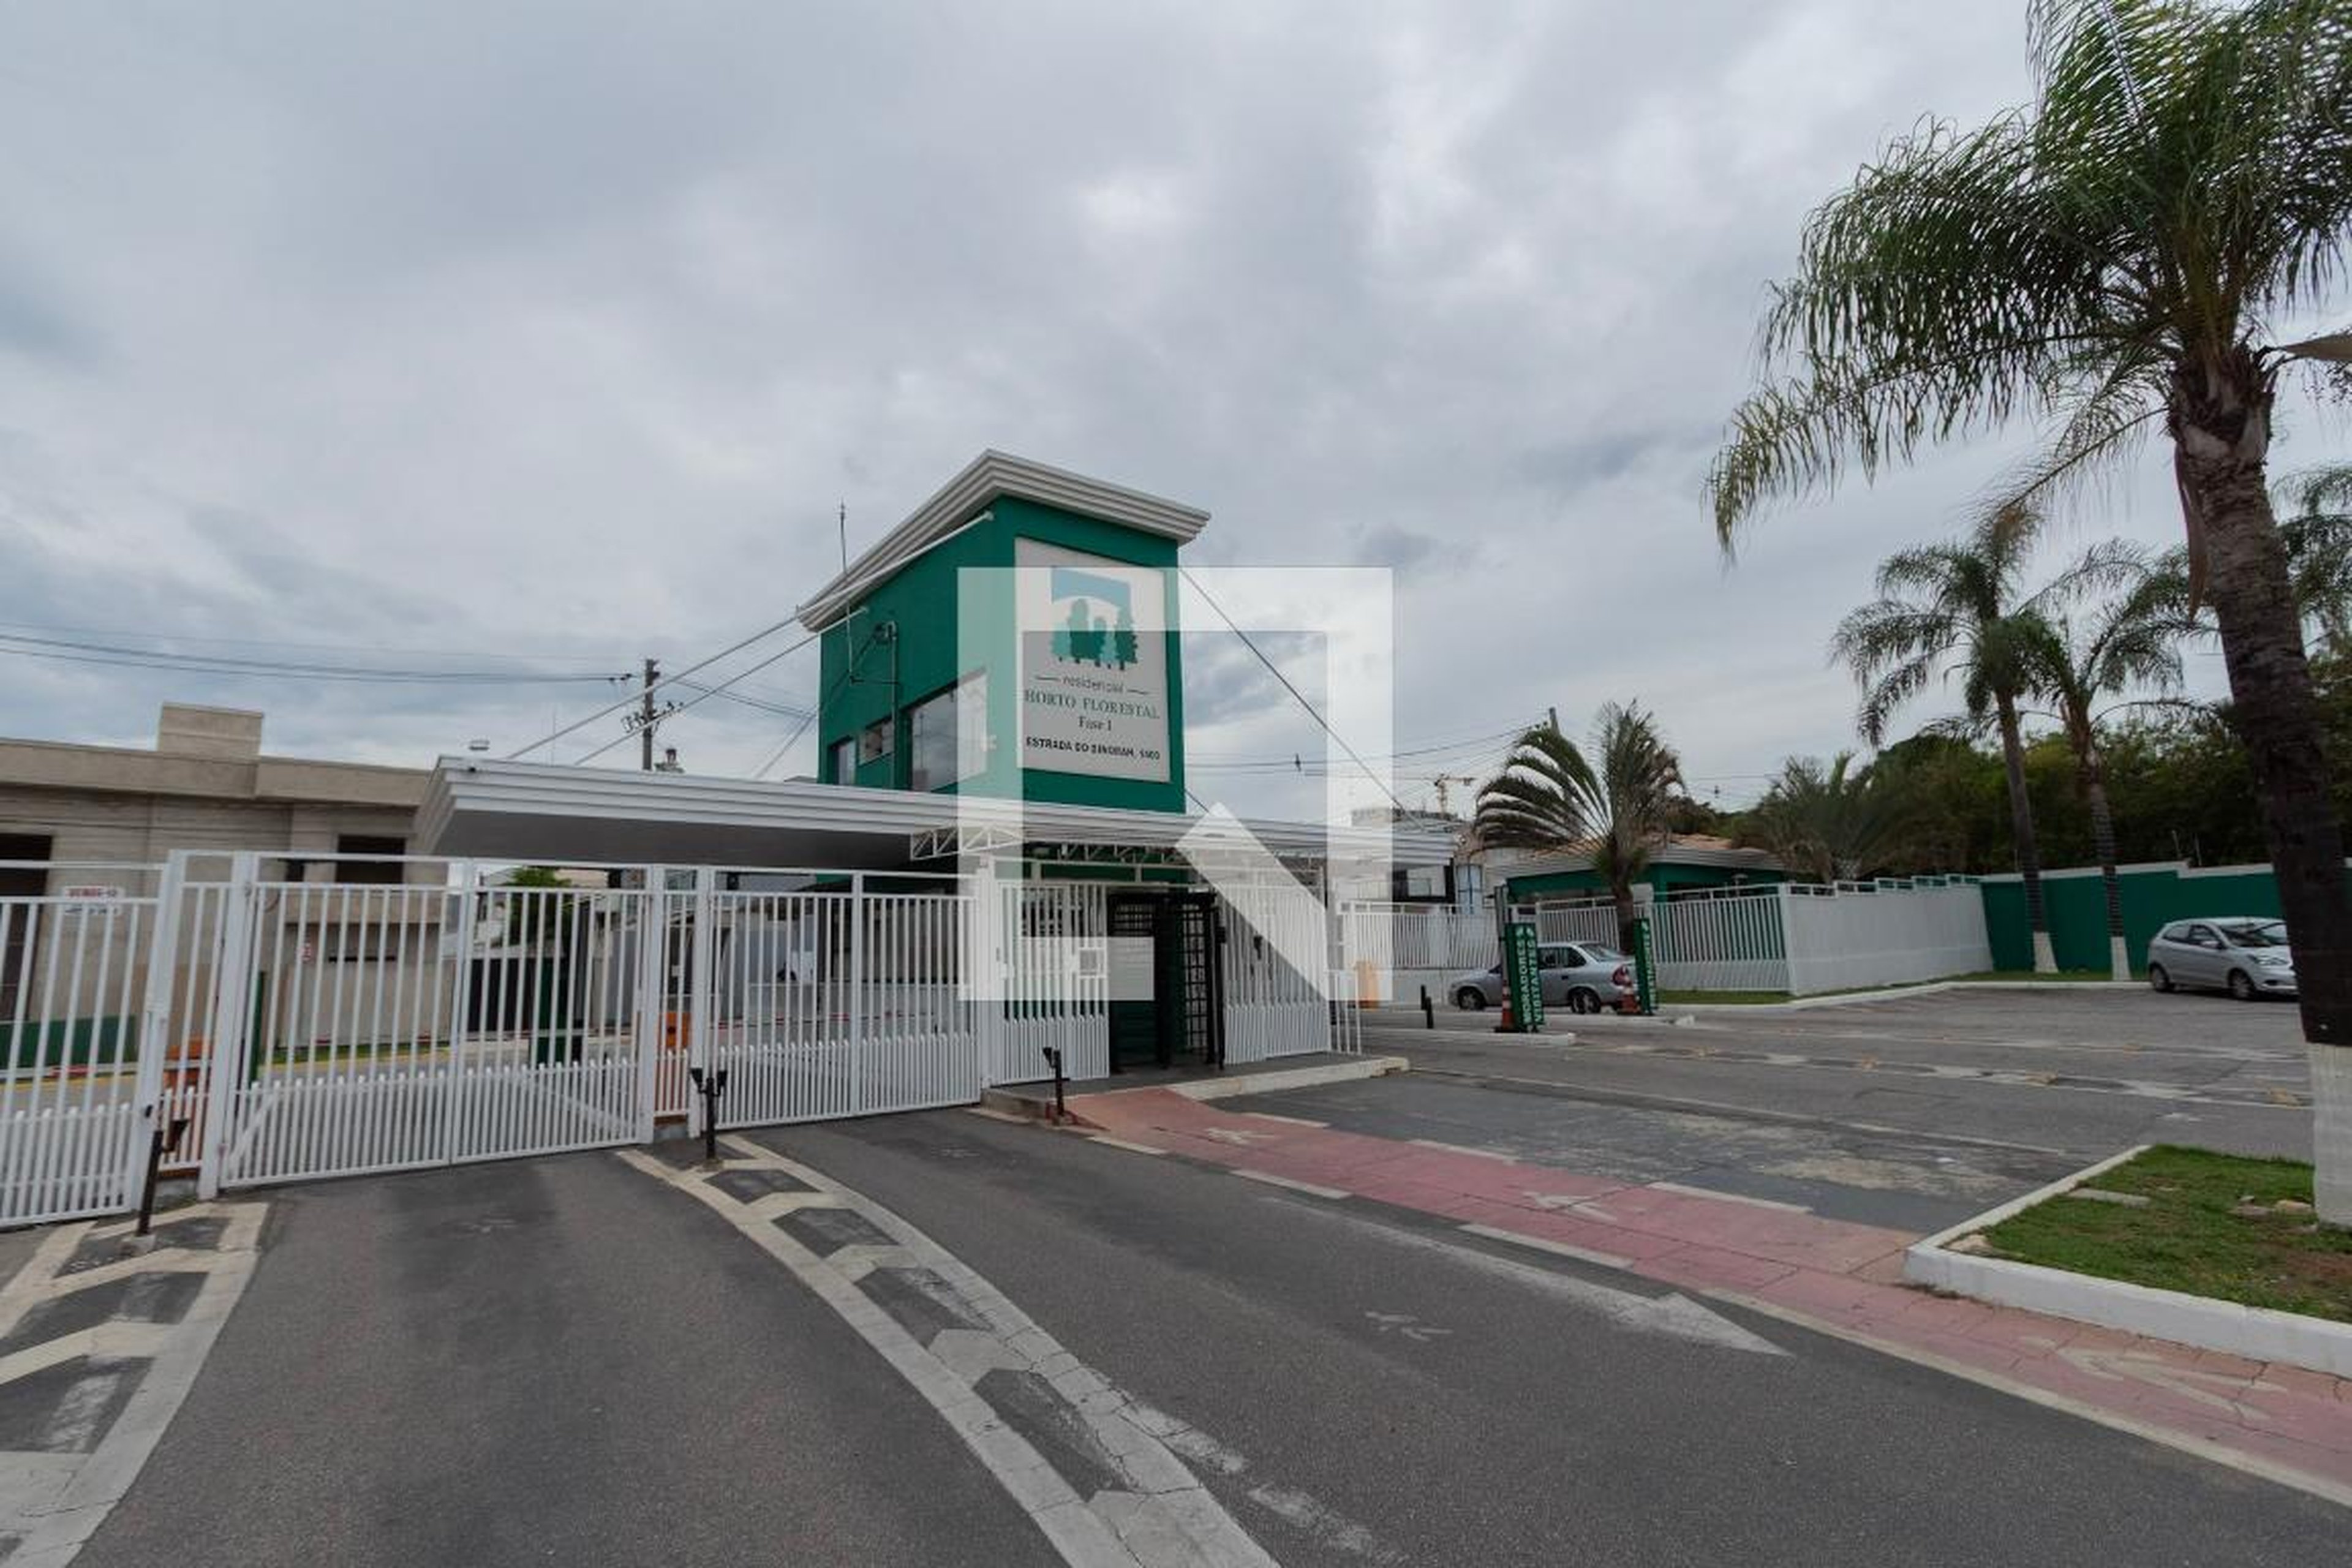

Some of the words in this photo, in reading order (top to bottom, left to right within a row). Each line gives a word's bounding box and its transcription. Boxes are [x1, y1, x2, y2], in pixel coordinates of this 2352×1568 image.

[1026, 690, 1076, 708] HORTO
[1083, 698, 1160, 719] FLORESTAL
[1079, 716, 1103, 730] Fase
[1027, 737, 1072, 751] ESTRADA
[1517, 940, 1532, 1024] MORADORES
